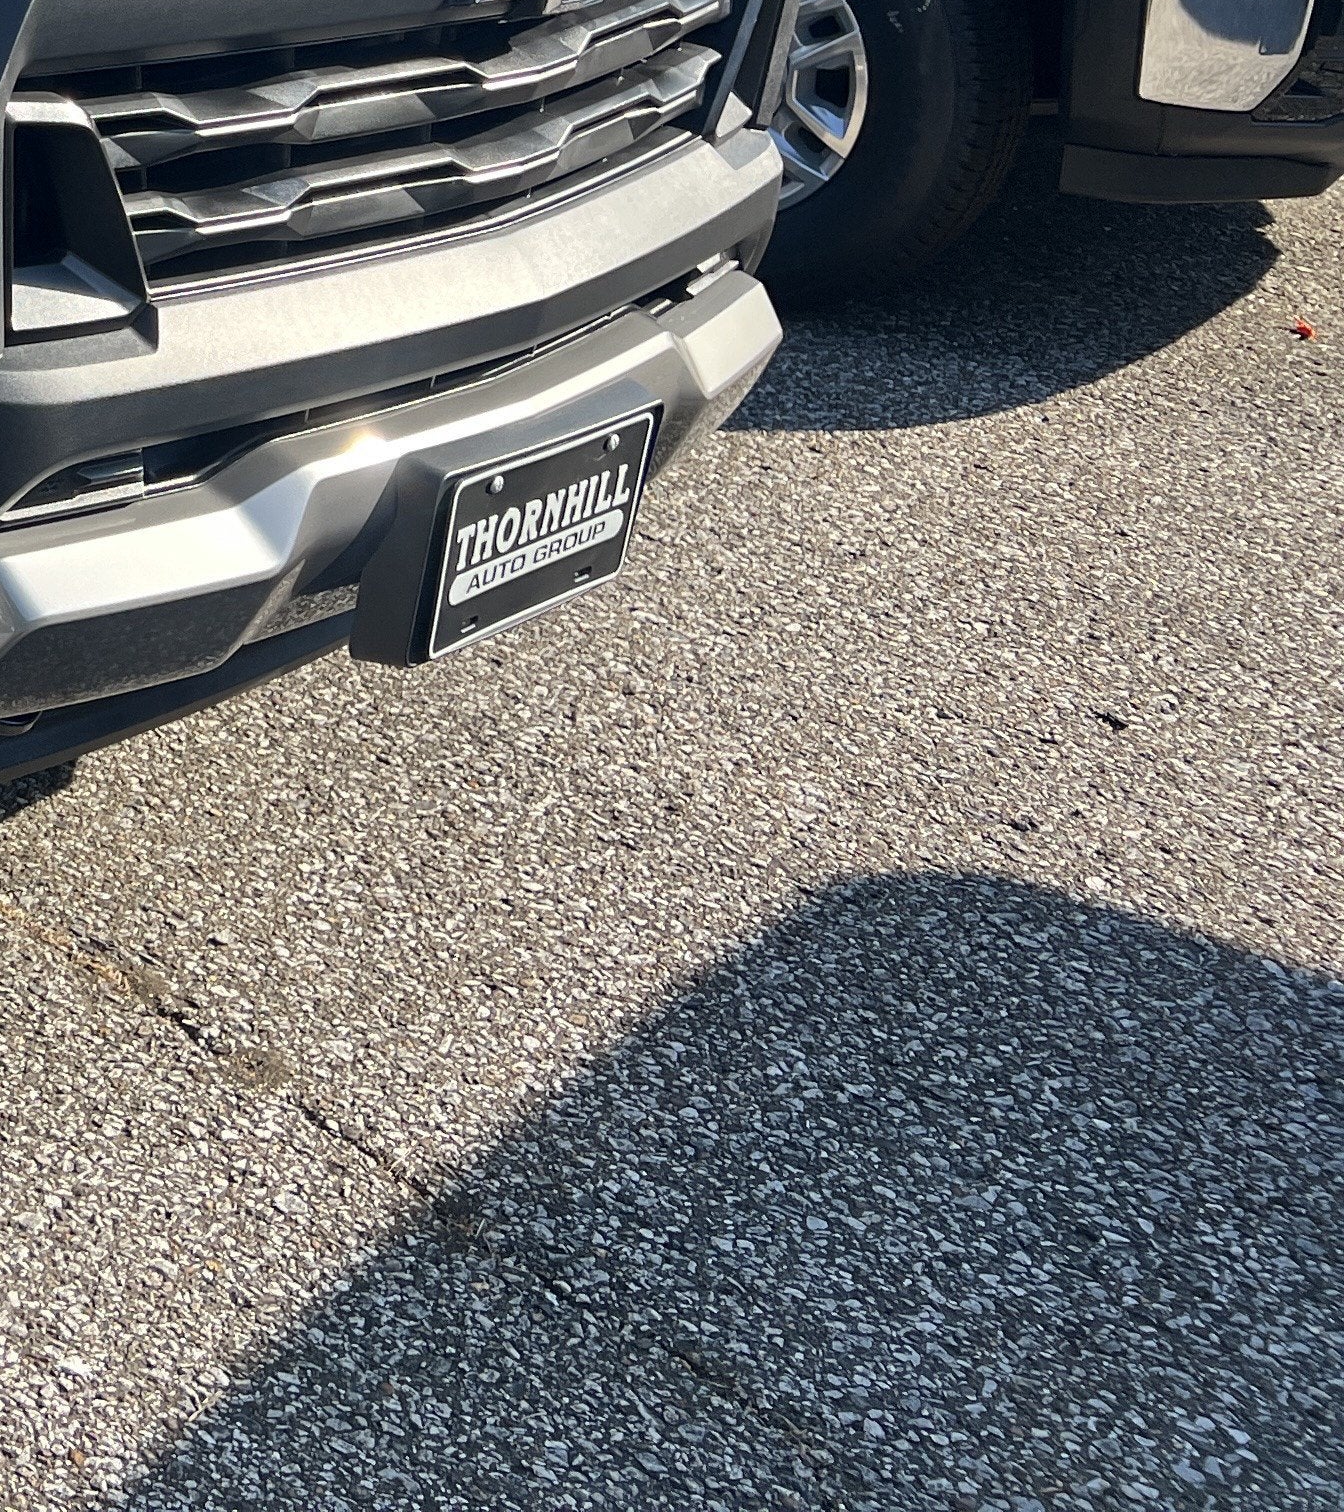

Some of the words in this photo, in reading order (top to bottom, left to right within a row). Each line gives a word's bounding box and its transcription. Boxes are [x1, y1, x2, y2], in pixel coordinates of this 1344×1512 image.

[456, 463, 631, 572] THORNHILL
[466, 555, 526, 595] AUTO
[533, 522, 606, 567] GROUP
